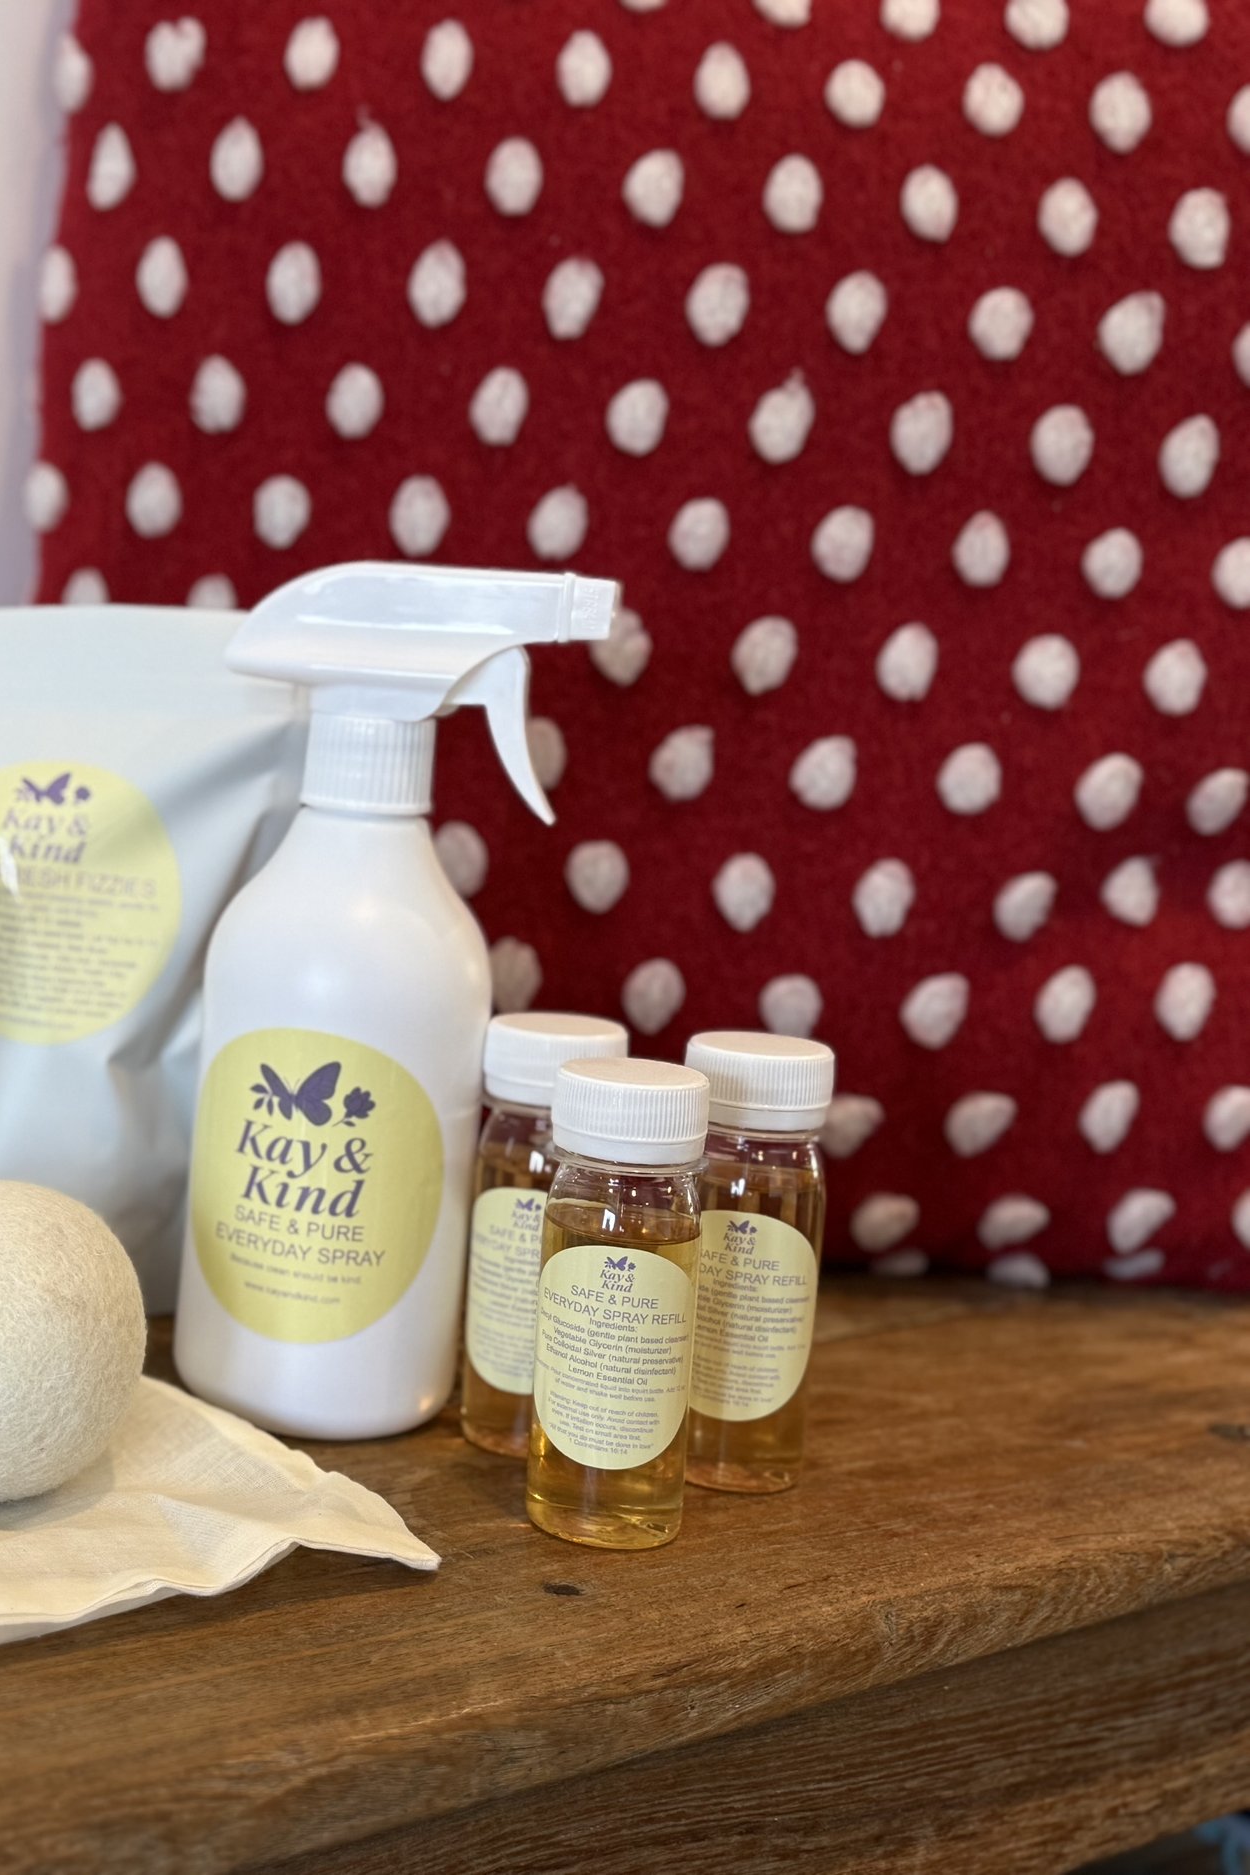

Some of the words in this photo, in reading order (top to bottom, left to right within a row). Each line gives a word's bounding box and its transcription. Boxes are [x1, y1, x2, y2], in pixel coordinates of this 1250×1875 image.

[234, 1117, 328, 1180] Kay
[332, 1137, 375, 1176] &
[239, 1163, 366, 1219] Kind
[233, 1204, 281, 1233] SAFE
[286, 1217, 300, 1237] &
[305, 1221, 366, 1244] PURE
[214, 1219, 313, 1262] EVERYDAY
[317, 1247, 387, 1269] SPRAY
[724, 1242, 755, 1256] Kind
[730, 1255, 740, 1268] &
[743, 1258, 781, 1272] PURE
[600, 1269, 626, 1285] Kay
[625, 1272, 637, 1284] &
[601, 1279, 634, 1294] Kind
[724, 1269, 771, 1286] SPRAY
[772, 1275, 808, 1287] REFILL
[543, 1286, 601, 1318] EVERYDAY
[603, 1308, 650, 1326] SPRAY
[651, 1312, 688, 1326] REFILL
[570, 1284, 606, 1304] SAFE
[607, 1293, 618, 1306] &
[621, 1295, 660, 1310] PURE
[589, 1317, 639, 1334] Ingredients:
[553, 1325, 588, 1346] Vegetable
[587, 1337, 625, 1353] Glycerin
[616, 1333, 639, 1345] plant
[639, 1335, 665, 1345] based
[568, 1353, 599, 1370] Alcohol
[599, 1362, 633, 1376] (natural
[583, 1346, 608, 1361] Silver
[608, 1352, 642, 1366] (natural
[568, 1362, 595, 1379] Lemon
[595, 1371, 636, 1386] Essential
[636, 1376, 649, 1387] Oil
